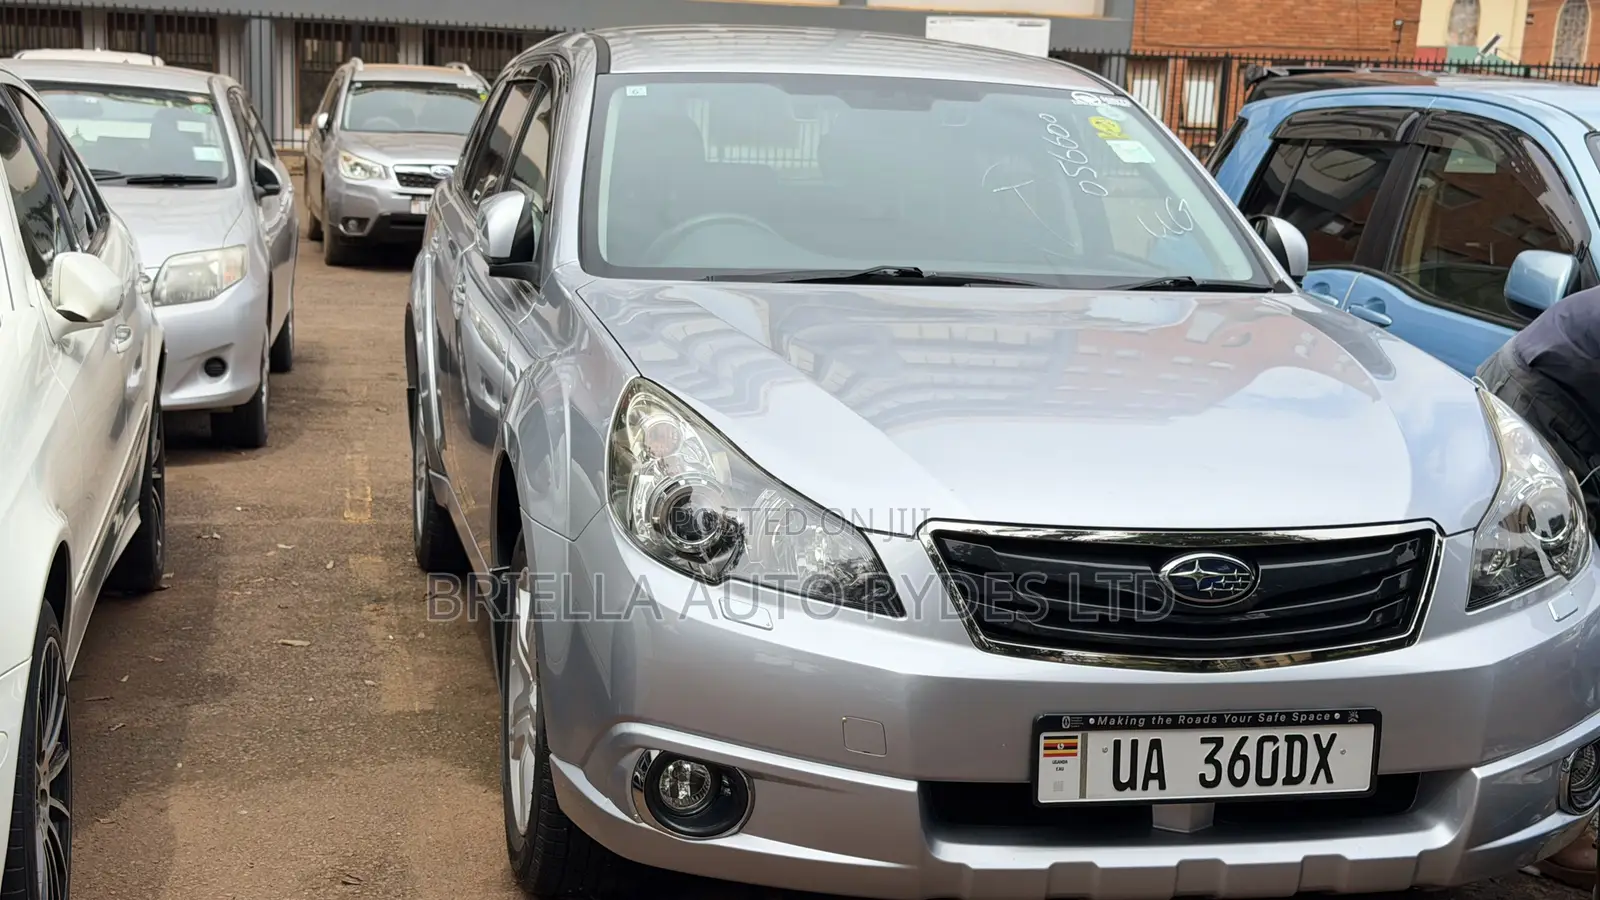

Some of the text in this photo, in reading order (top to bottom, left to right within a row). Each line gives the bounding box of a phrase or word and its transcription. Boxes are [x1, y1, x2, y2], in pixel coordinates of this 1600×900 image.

[1097, 715, 1146, 727] Making
[1151, 715, 1172, 725] the
[1178, 714, 1218, 725] Roads
[1223, 713, 1253, 724] Your
[1257, 712, 1286, 722] Safe
[1292, 711, 1330, 723] Space
[1112, 732, 1338, 792] UA 360DX
